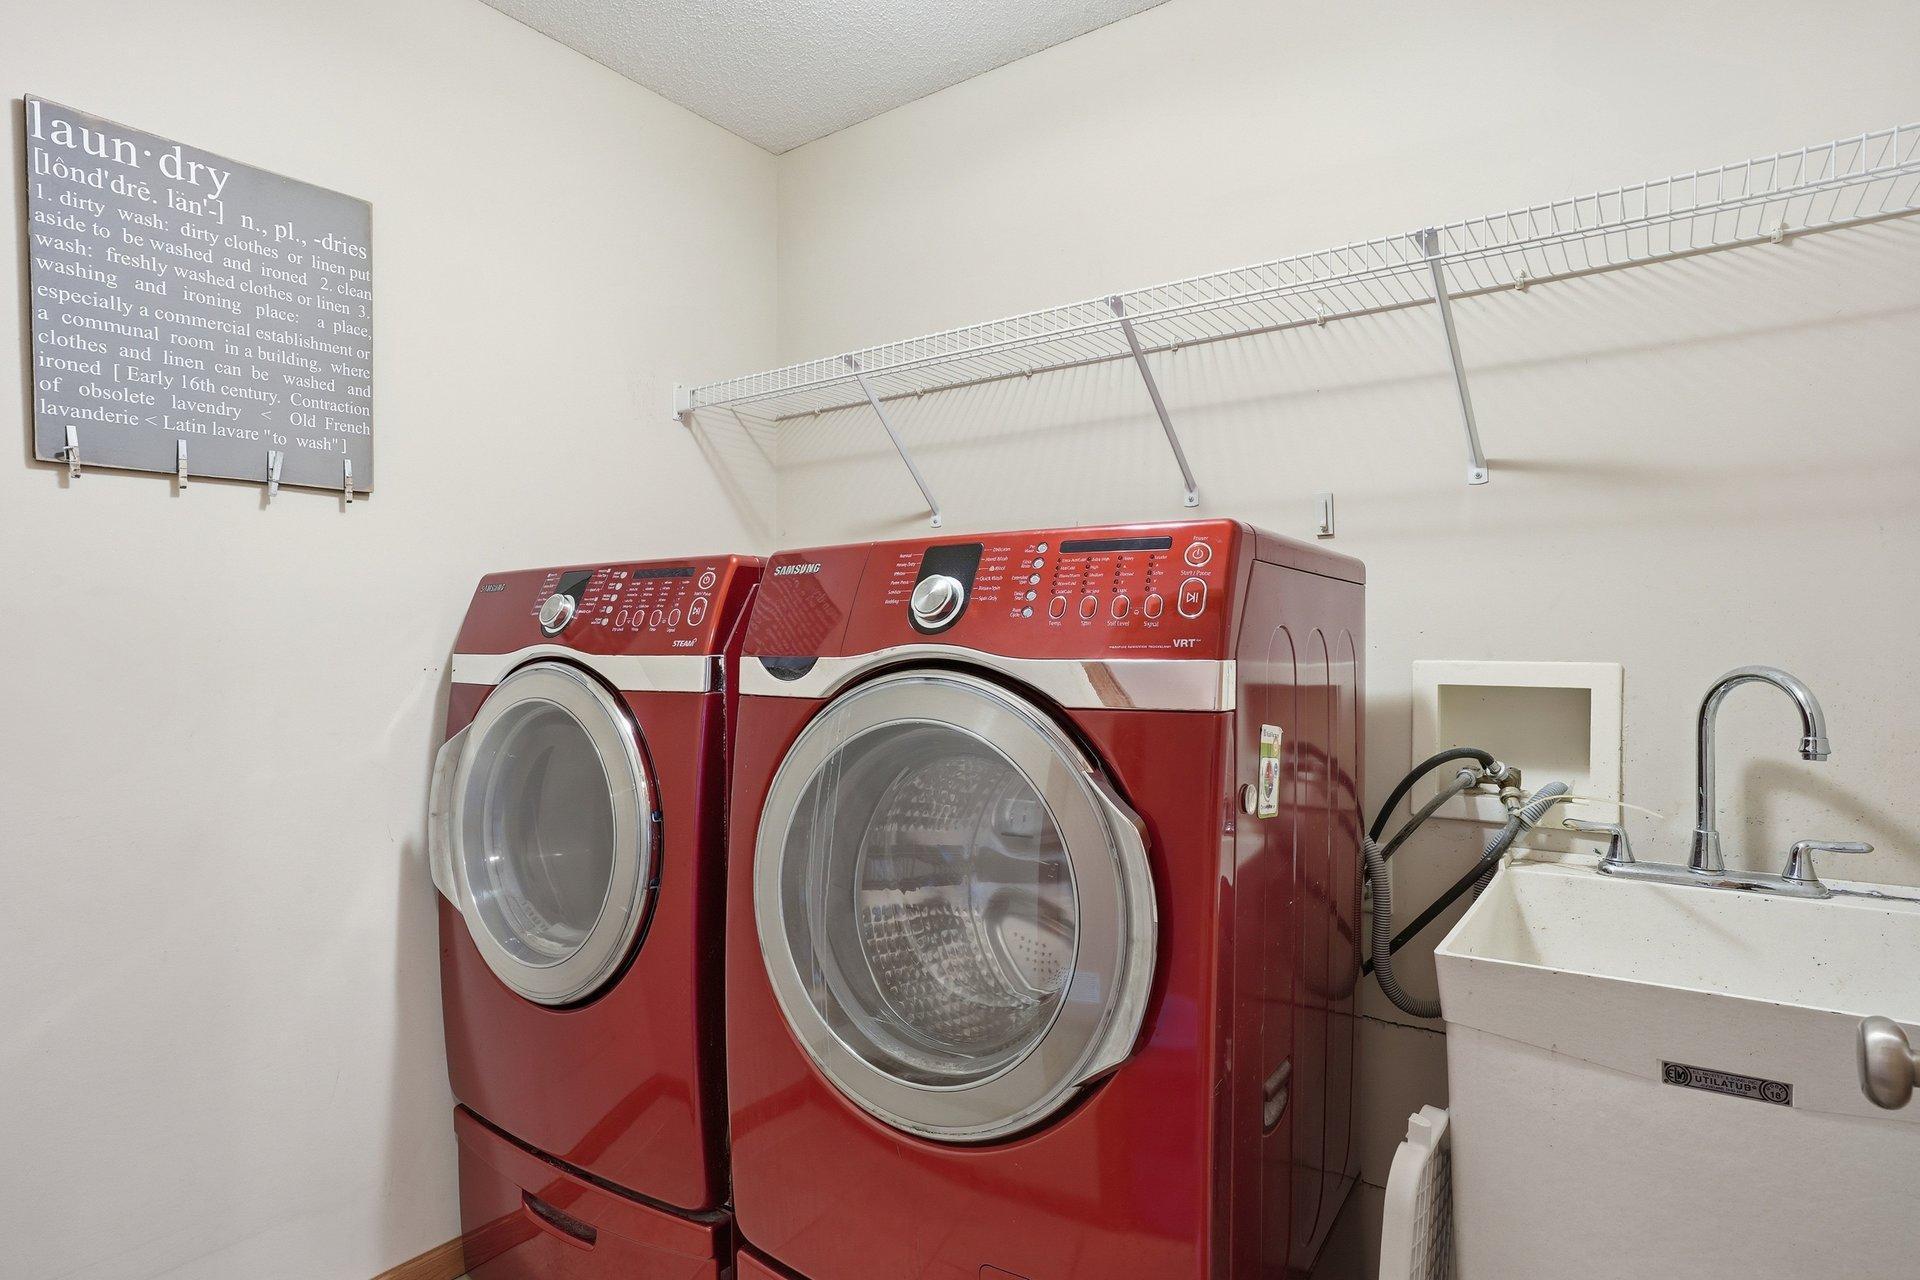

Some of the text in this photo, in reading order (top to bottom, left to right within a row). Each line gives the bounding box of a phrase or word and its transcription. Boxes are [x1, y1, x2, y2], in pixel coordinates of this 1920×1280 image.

[34, 208, 373, 301] aside to be washed and ironed 2. clean
[36, 184, 371, 283] 1. dirty wash: dirty clothes or linen put
[241, 213, 267, 238] n.,
[274, 221, 306, 248] pl.,
[314, 232, 368, 261] -dries
[34, 233, 370, 320] wash: freshly washed clothes or linen 3.
[36, 257, 372, 341] washing and ironing place: a place,
[37, 307, 371, 379] a communal room in a building, where
[38, 285, 370, 361] especially a commercial establishment or
[39, 330, 371, 398] clothes and linen can be washed and
[39, 351, 102, 376] ironed
[126, 366, 174, 389] Early
[181, 374, 215, 395] 16th
[221, 384, 280, 405] century.
[290, 392, 371, 417] Contraction
[39, 376, 62, 393] of
[79, 383, 156, 407] obsolete
[172, 395, 242, 421] lavendry
[289, 411, 317, 428] Old
[325, 416, 371, 436] French
[41, 398, 139, 426] lavanderie
[163, 414, 207, 436] Latin
[213, 421, 260, 442] lavare
[774, 563, 821, 576] SAMSUNG
